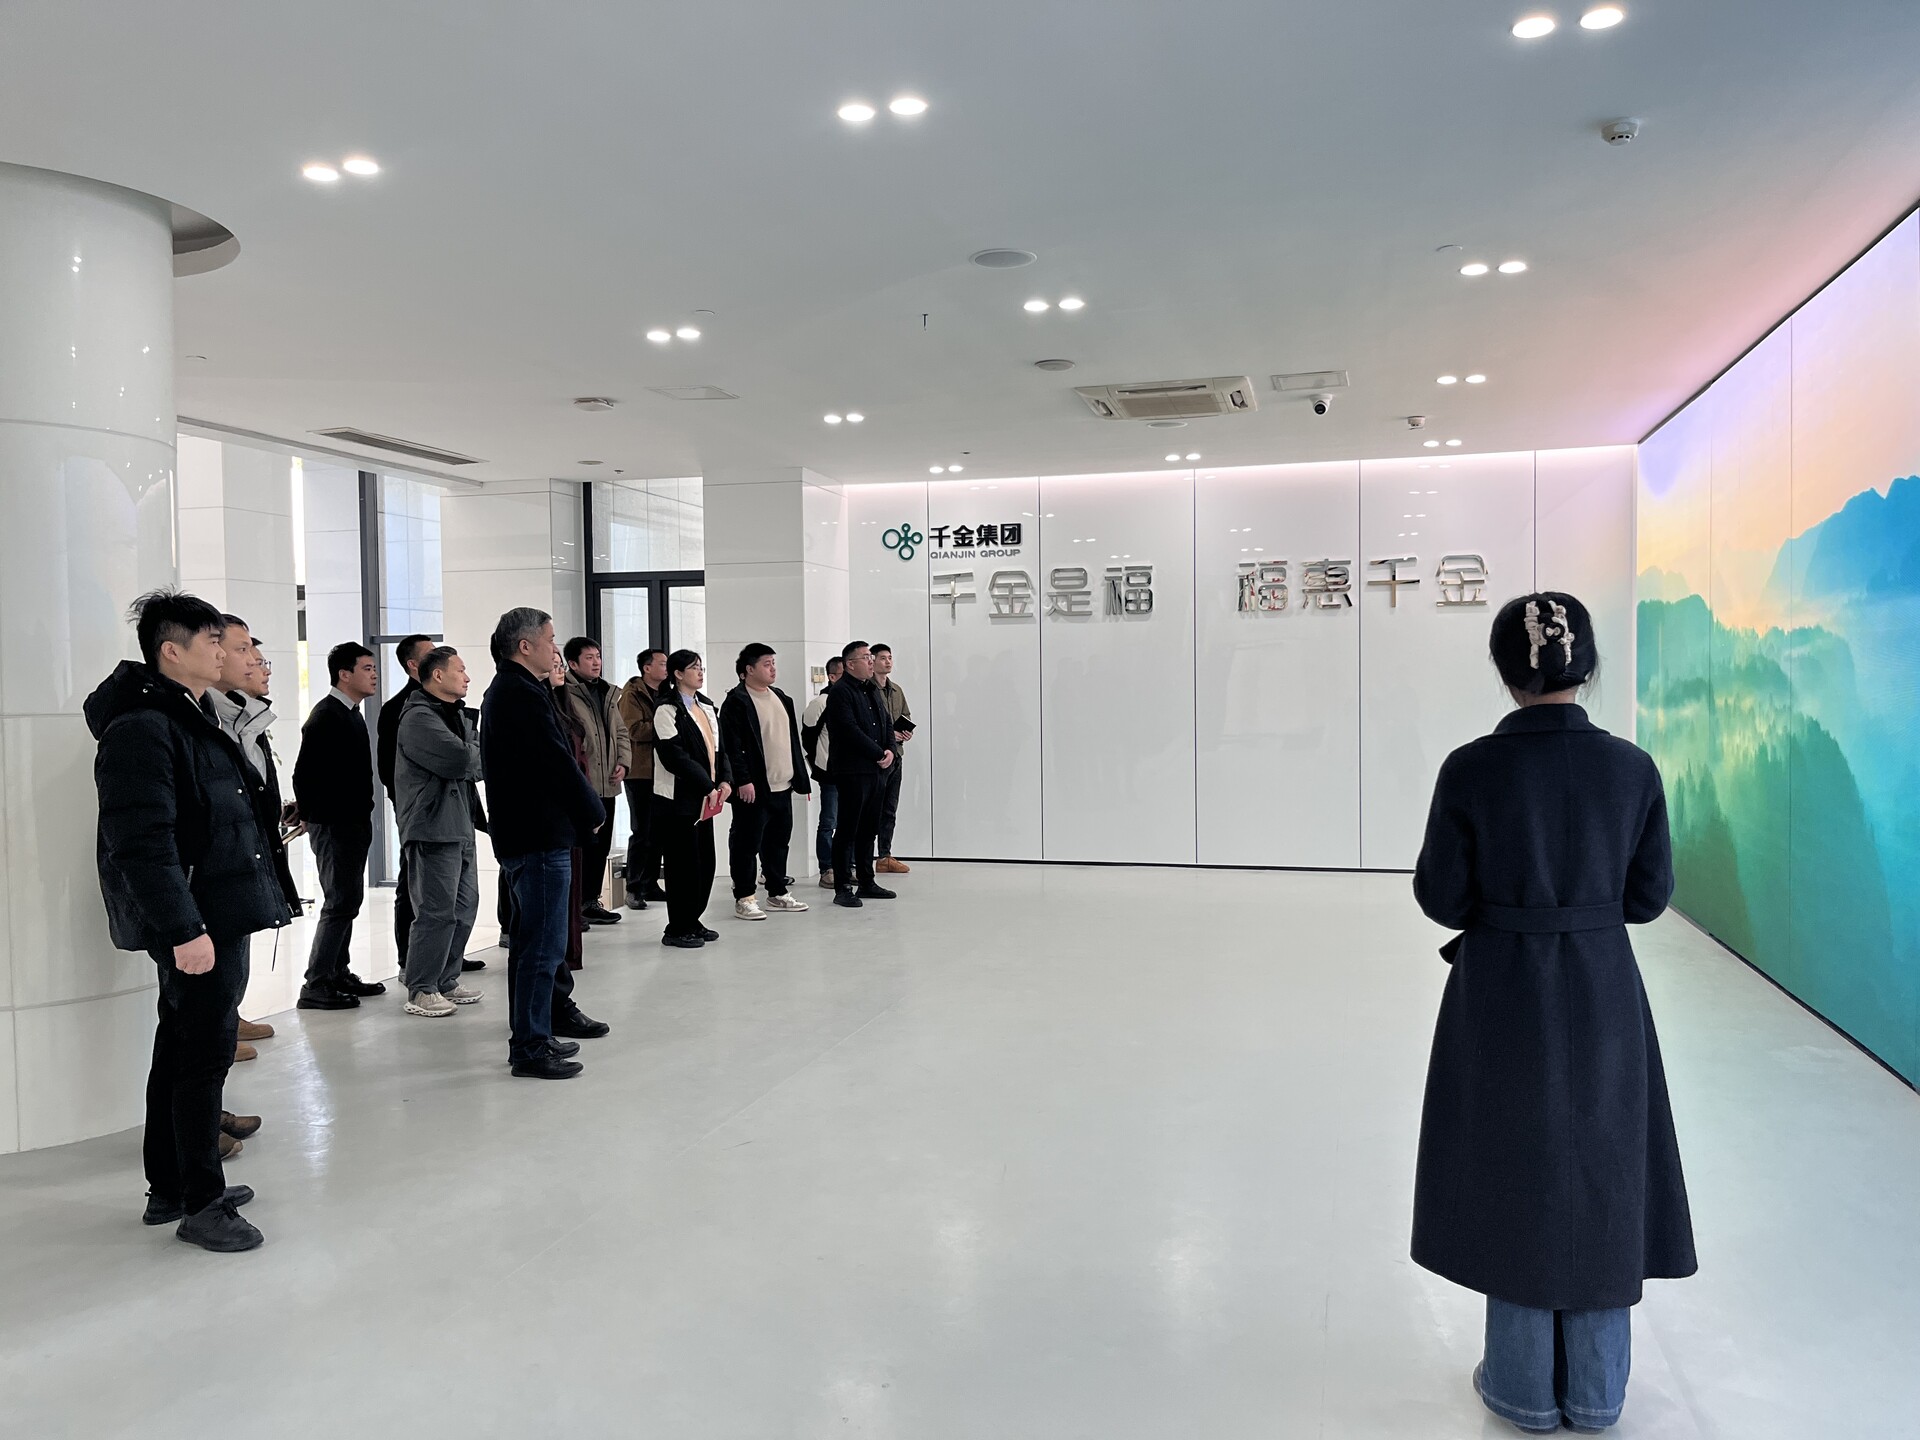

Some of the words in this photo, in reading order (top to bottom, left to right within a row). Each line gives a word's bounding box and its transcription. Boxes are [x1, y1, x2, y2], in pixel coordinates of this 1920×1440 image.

[929, 523, 1022, 548] 千金集团
[930, 550, 976, 560] QIANJIN
[980, 548, 1021, 558] GROUP
[931, 565, 1153, 620] 千金是福
[1237, 554, 1489, 611] 福惠千金
